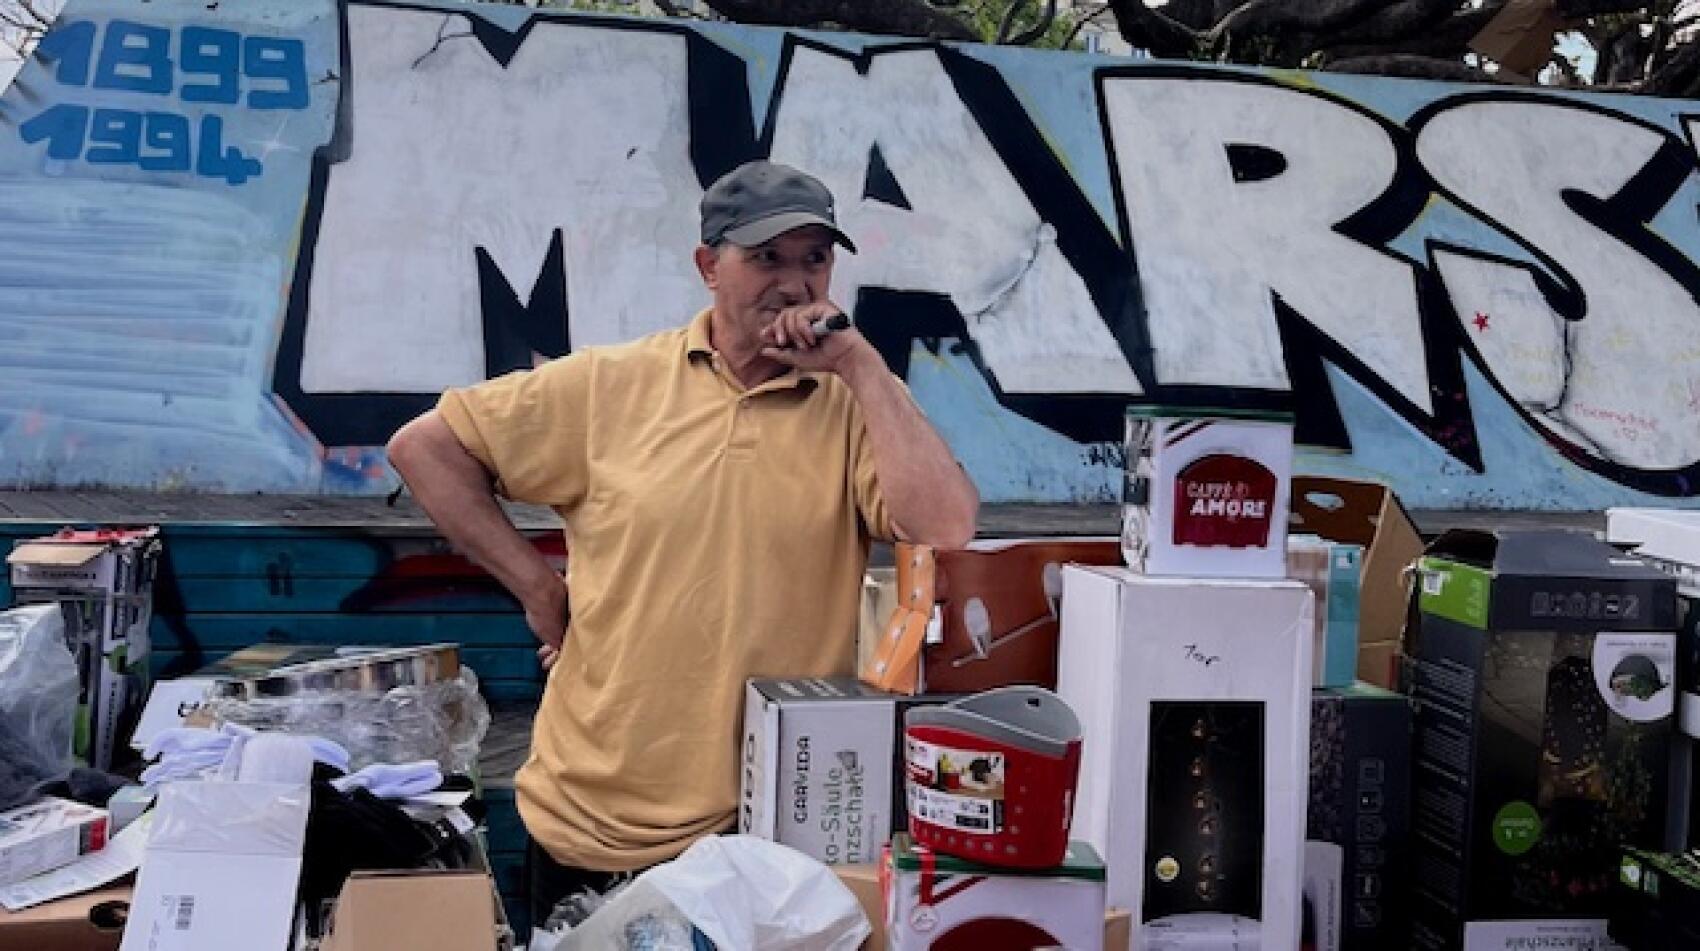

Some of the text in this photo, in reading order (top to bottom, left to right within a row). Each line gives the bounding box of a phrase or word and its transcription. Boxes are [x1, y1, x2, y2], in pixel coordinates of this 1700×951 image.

[38, 20, 310, 110] 1899
[19, 104, 263, 186] 1994
[277, 1, 1700, 490] MARS
[1189, 499, 1266, 519] AMORE
